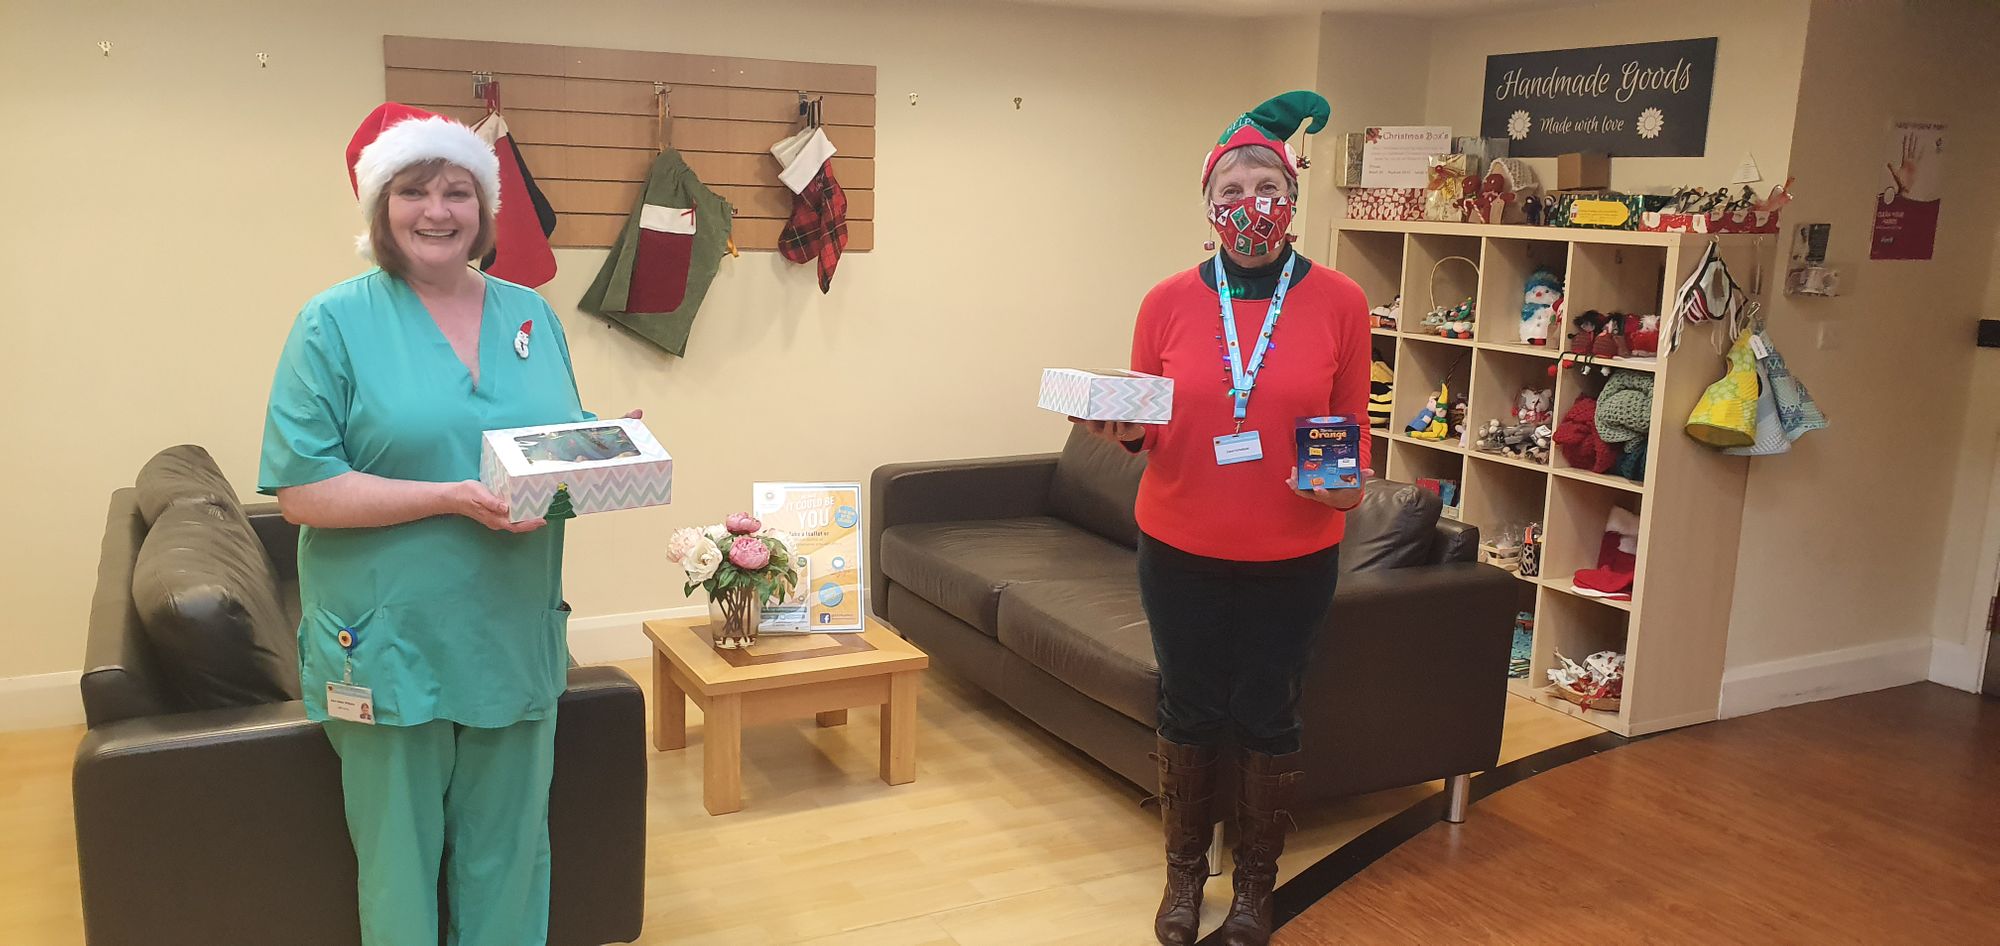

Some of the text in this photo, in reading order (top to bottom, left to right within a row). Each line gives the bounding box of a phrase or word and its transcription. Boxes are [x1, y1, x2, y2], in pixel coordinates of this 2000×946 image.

[1496, 58, 1692, 102] Handmade Goods
[1539, 116, 1625, 134] Made with love
[1383, 132, 1424, 140] Christmas
[1309, 429, 1347, 440] Orange
[825, 496, 835, 506] BE
[799, 508, 830, 529] YOU
